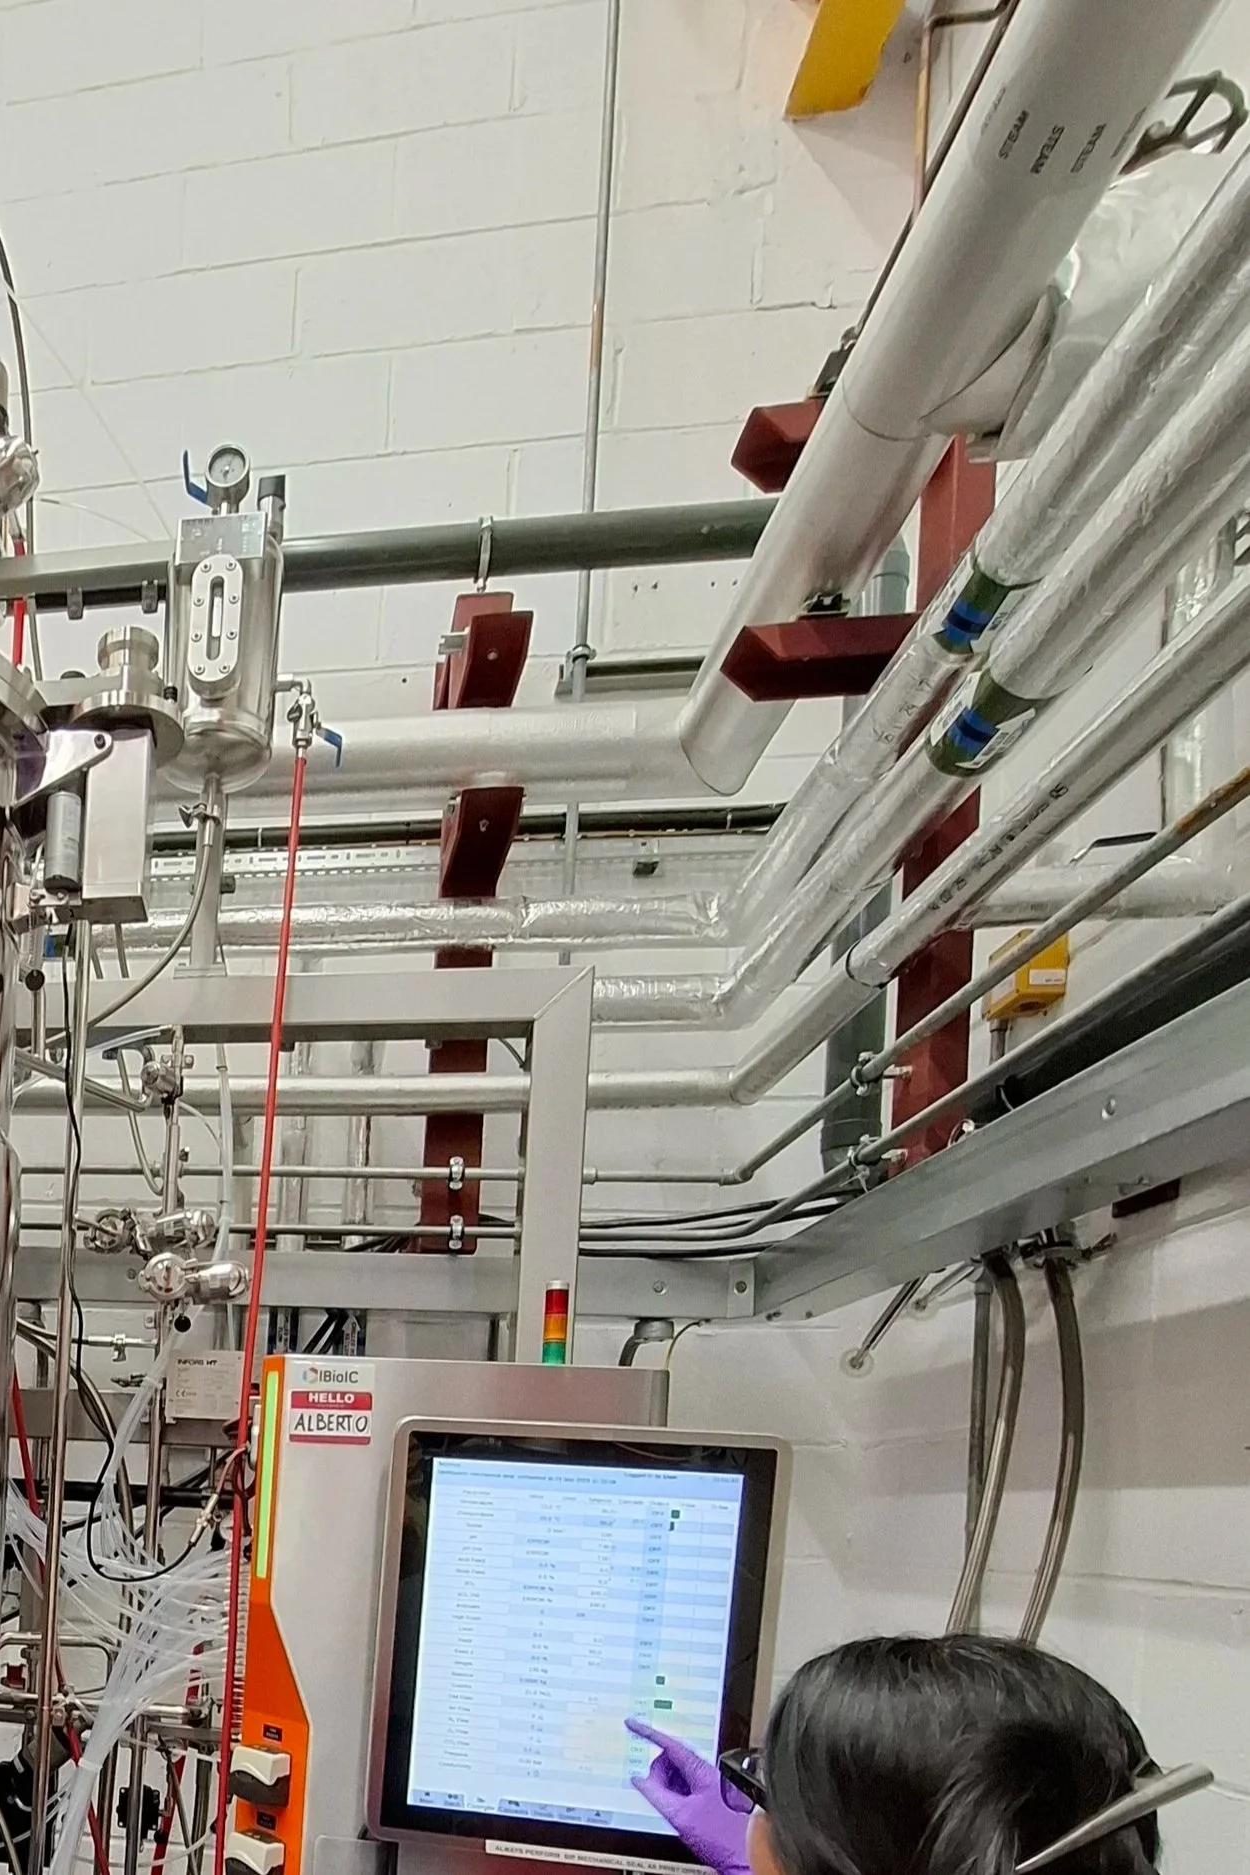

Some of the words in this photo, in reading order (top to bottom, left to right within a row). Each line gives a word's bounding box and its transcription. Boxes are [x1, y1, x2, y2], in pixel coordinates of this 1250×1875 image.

[1030, 125, 1065, 174] STEAM
[308, 1392, 355, 1404] HELLO
[294, 1412, 369, 1433] ALBERTO
